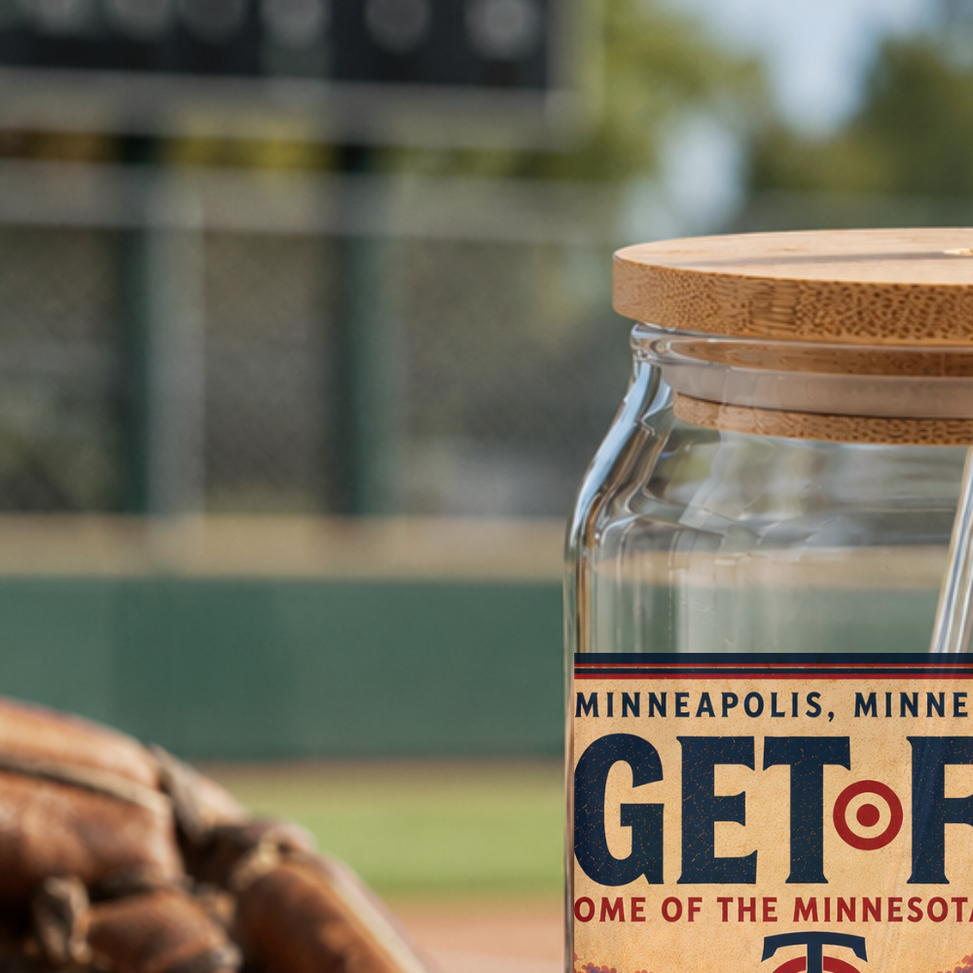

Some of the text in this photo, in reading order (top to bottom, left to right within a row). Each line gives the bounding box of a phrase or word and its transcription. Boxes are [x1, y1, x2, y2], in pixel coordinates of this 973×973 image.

[575, 691, 835, 722] MINNEAPOLIS,
[574, 733, 851, 887] GET
[661, 896, 702, 922] OF
[717, 896, 778, 922] THE
